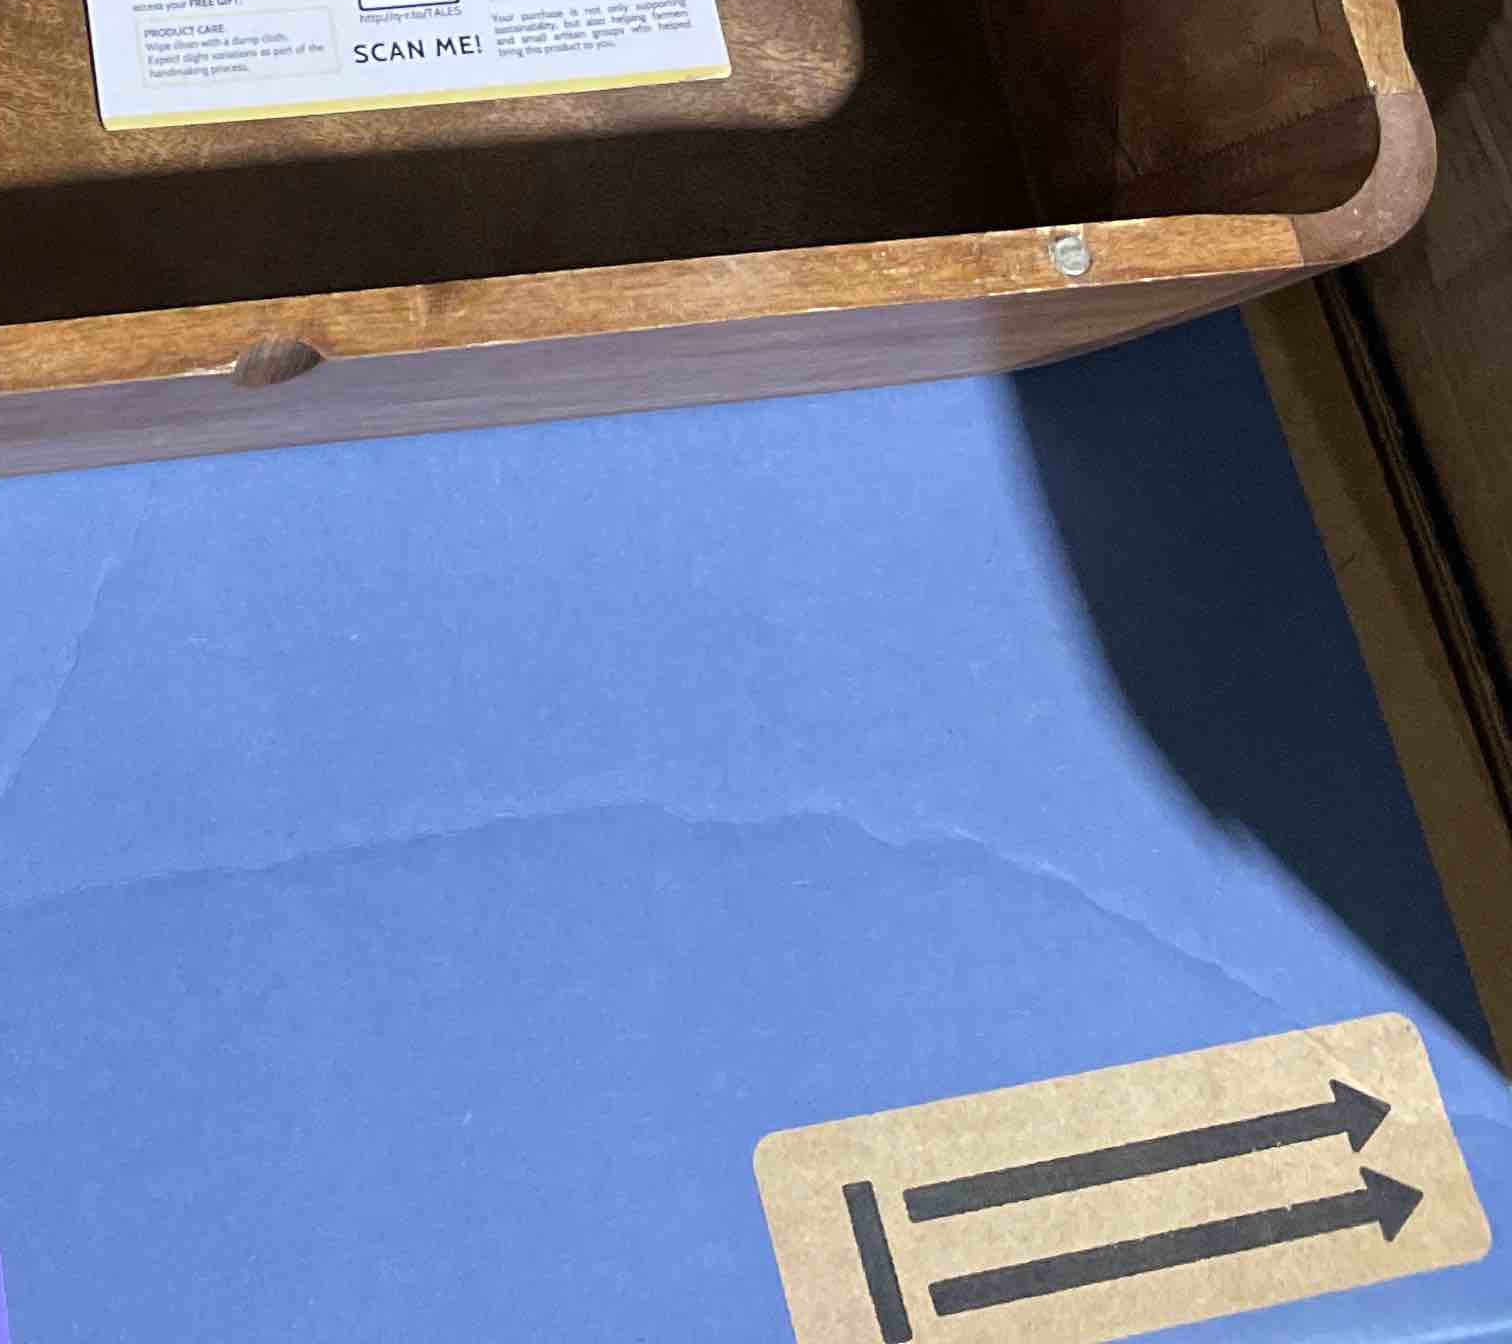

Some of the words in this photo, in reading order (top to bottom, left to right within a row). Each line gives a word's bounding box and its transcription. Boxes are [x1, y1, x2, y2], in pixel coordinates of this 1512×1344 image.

[144, 28, 193, 38] PRODUCT
[197, 25, 224, 34] CARE
[354, 40, 425, 63] SCAN
[436, 35, 483, 56] ME!
